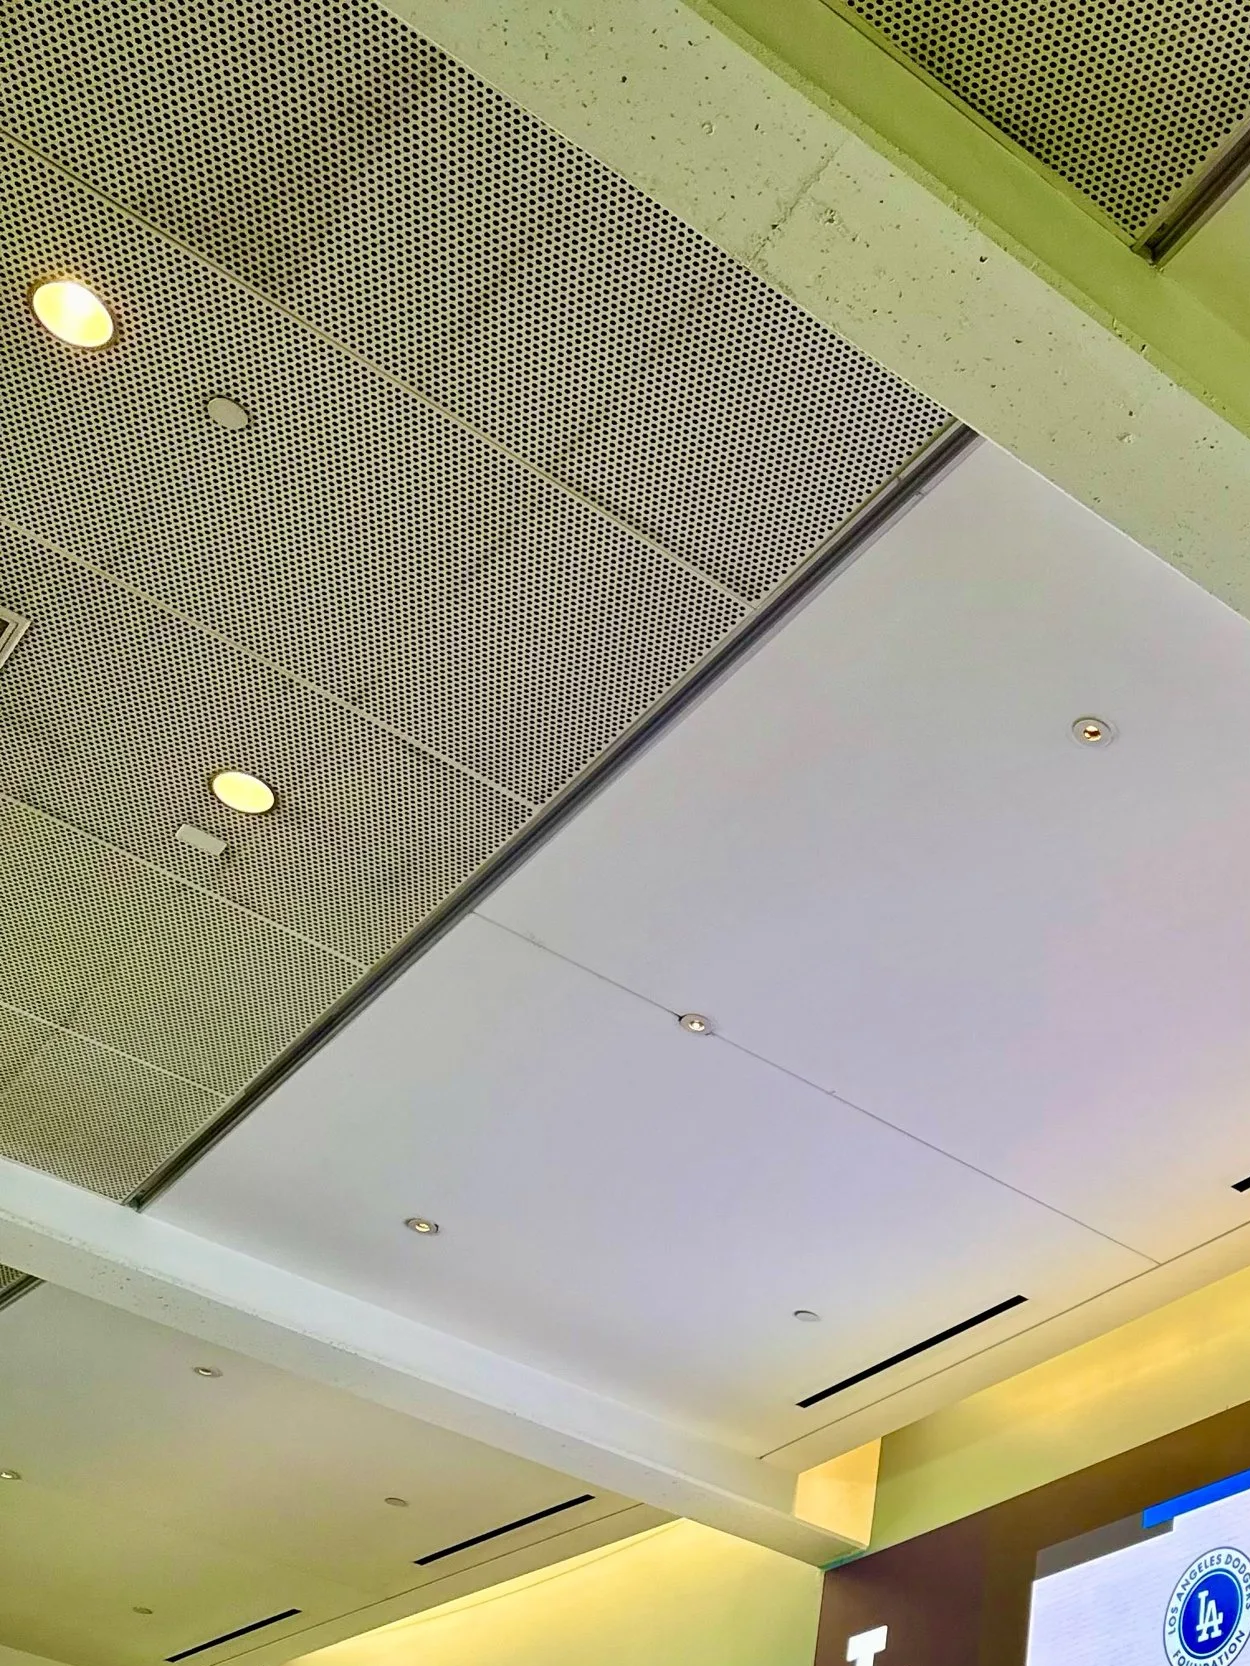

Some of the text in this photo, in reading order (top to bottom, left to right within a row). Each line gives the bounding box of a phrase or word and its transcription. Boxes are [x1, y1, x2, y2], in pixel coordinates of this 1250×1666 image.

[1168, 1606, 1179, 1635] LOS
[1177, 1553, 1222, 1602] ANGELES
[1196, 1590, 1223, 1643] LA
